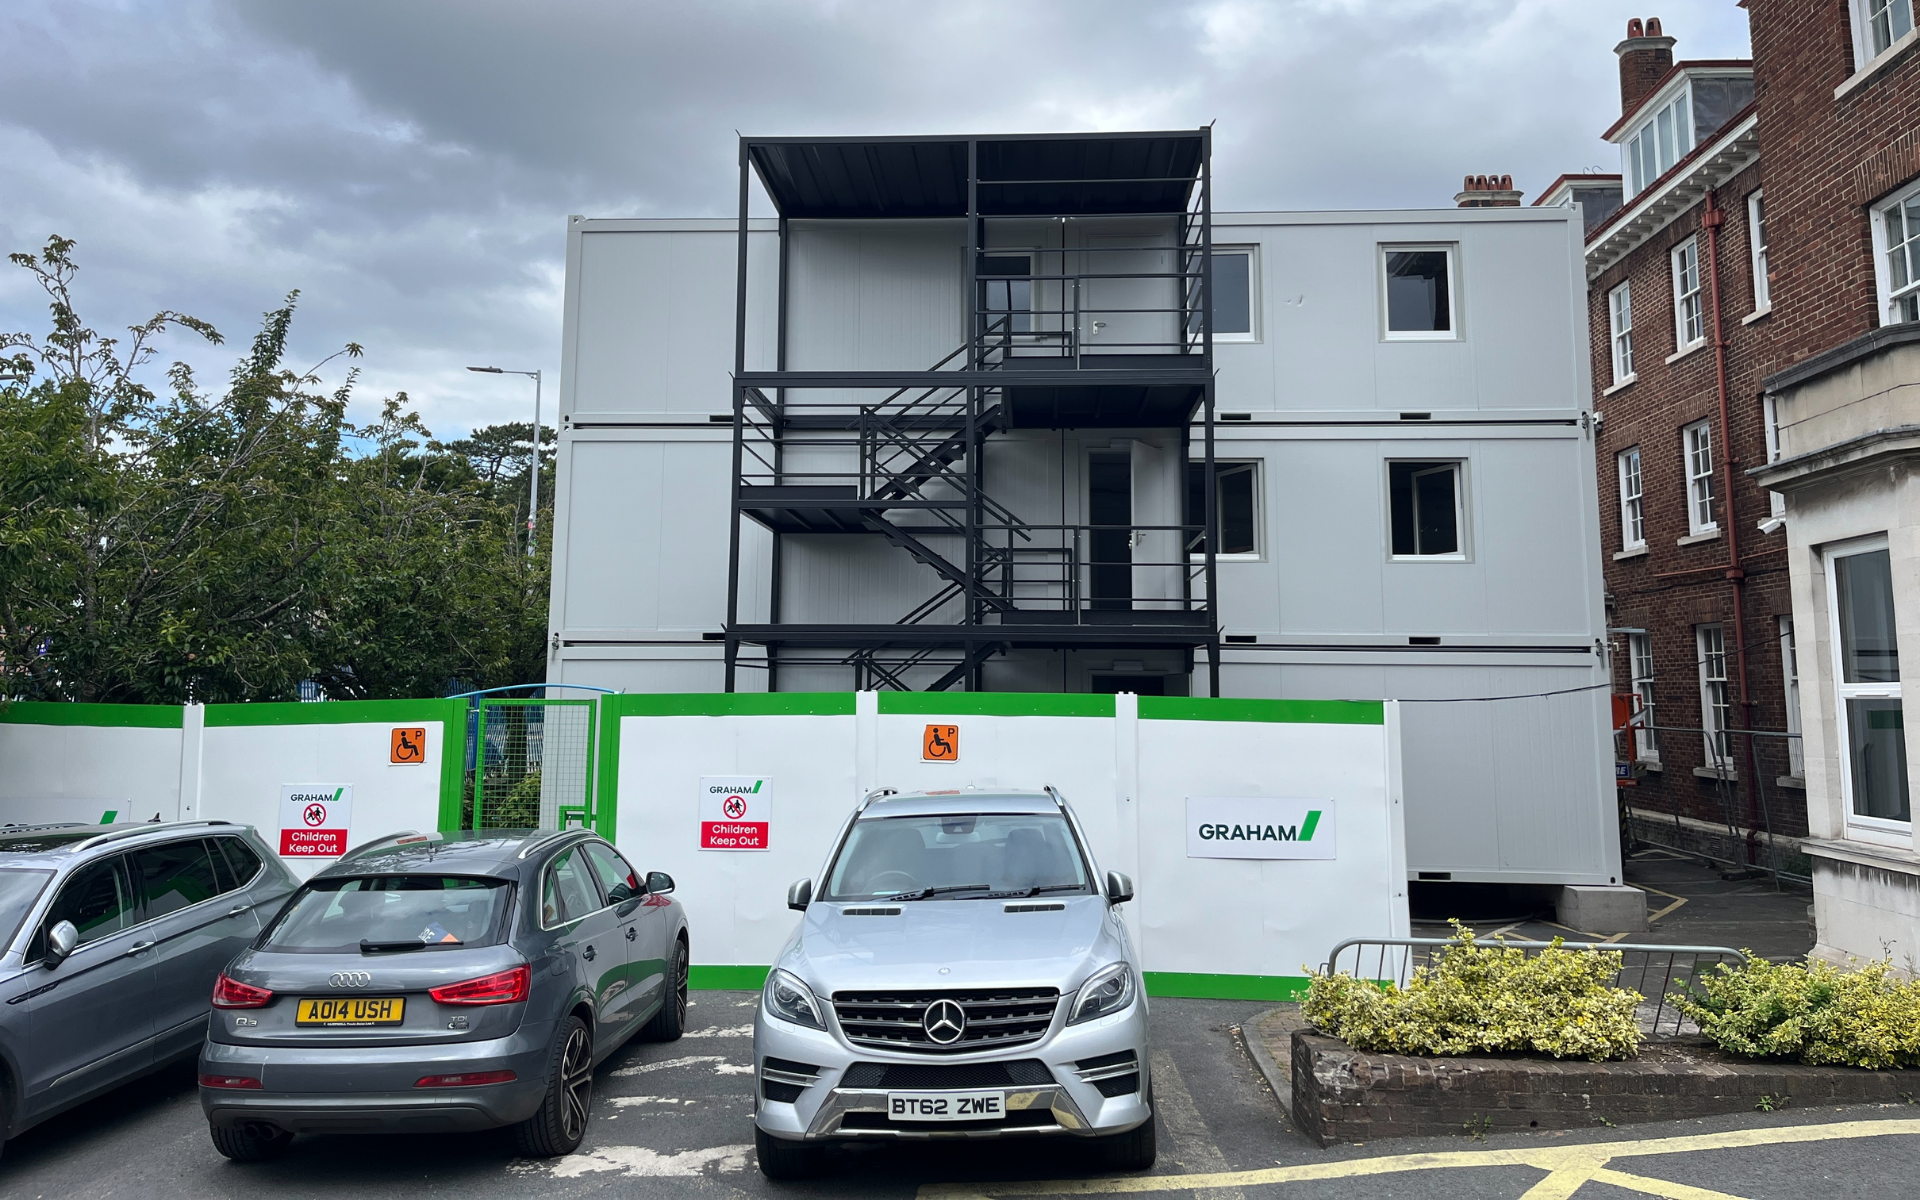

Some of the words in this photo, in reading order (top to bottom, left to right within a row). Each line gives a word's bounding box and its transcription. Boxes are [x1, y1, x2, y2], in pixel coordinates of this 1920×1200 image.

[415, 731, 422, 740] P
[948, 728, 955, 737] P
[709, 786, 752, 794] GRAHAM
[712, 824, 757, 834] Children
[1198, 823, 1297, 841] GRAHAM
[291, 832, 336, 841] Children
[710, 836, 737, 846] Keep
[739, 836, 759, 845] Out
[289, 843, 315, 854] Keep
[317, 843, 337, 852] Out
[308, 1001, 349, 1019] AO14
[355, 1000, 392, 1018] USH
[236, 1017, 257, 1026] Q3
[891, 1098, 948, 1115] BT62
[956, 1096, 1000, 1114] ZWE
